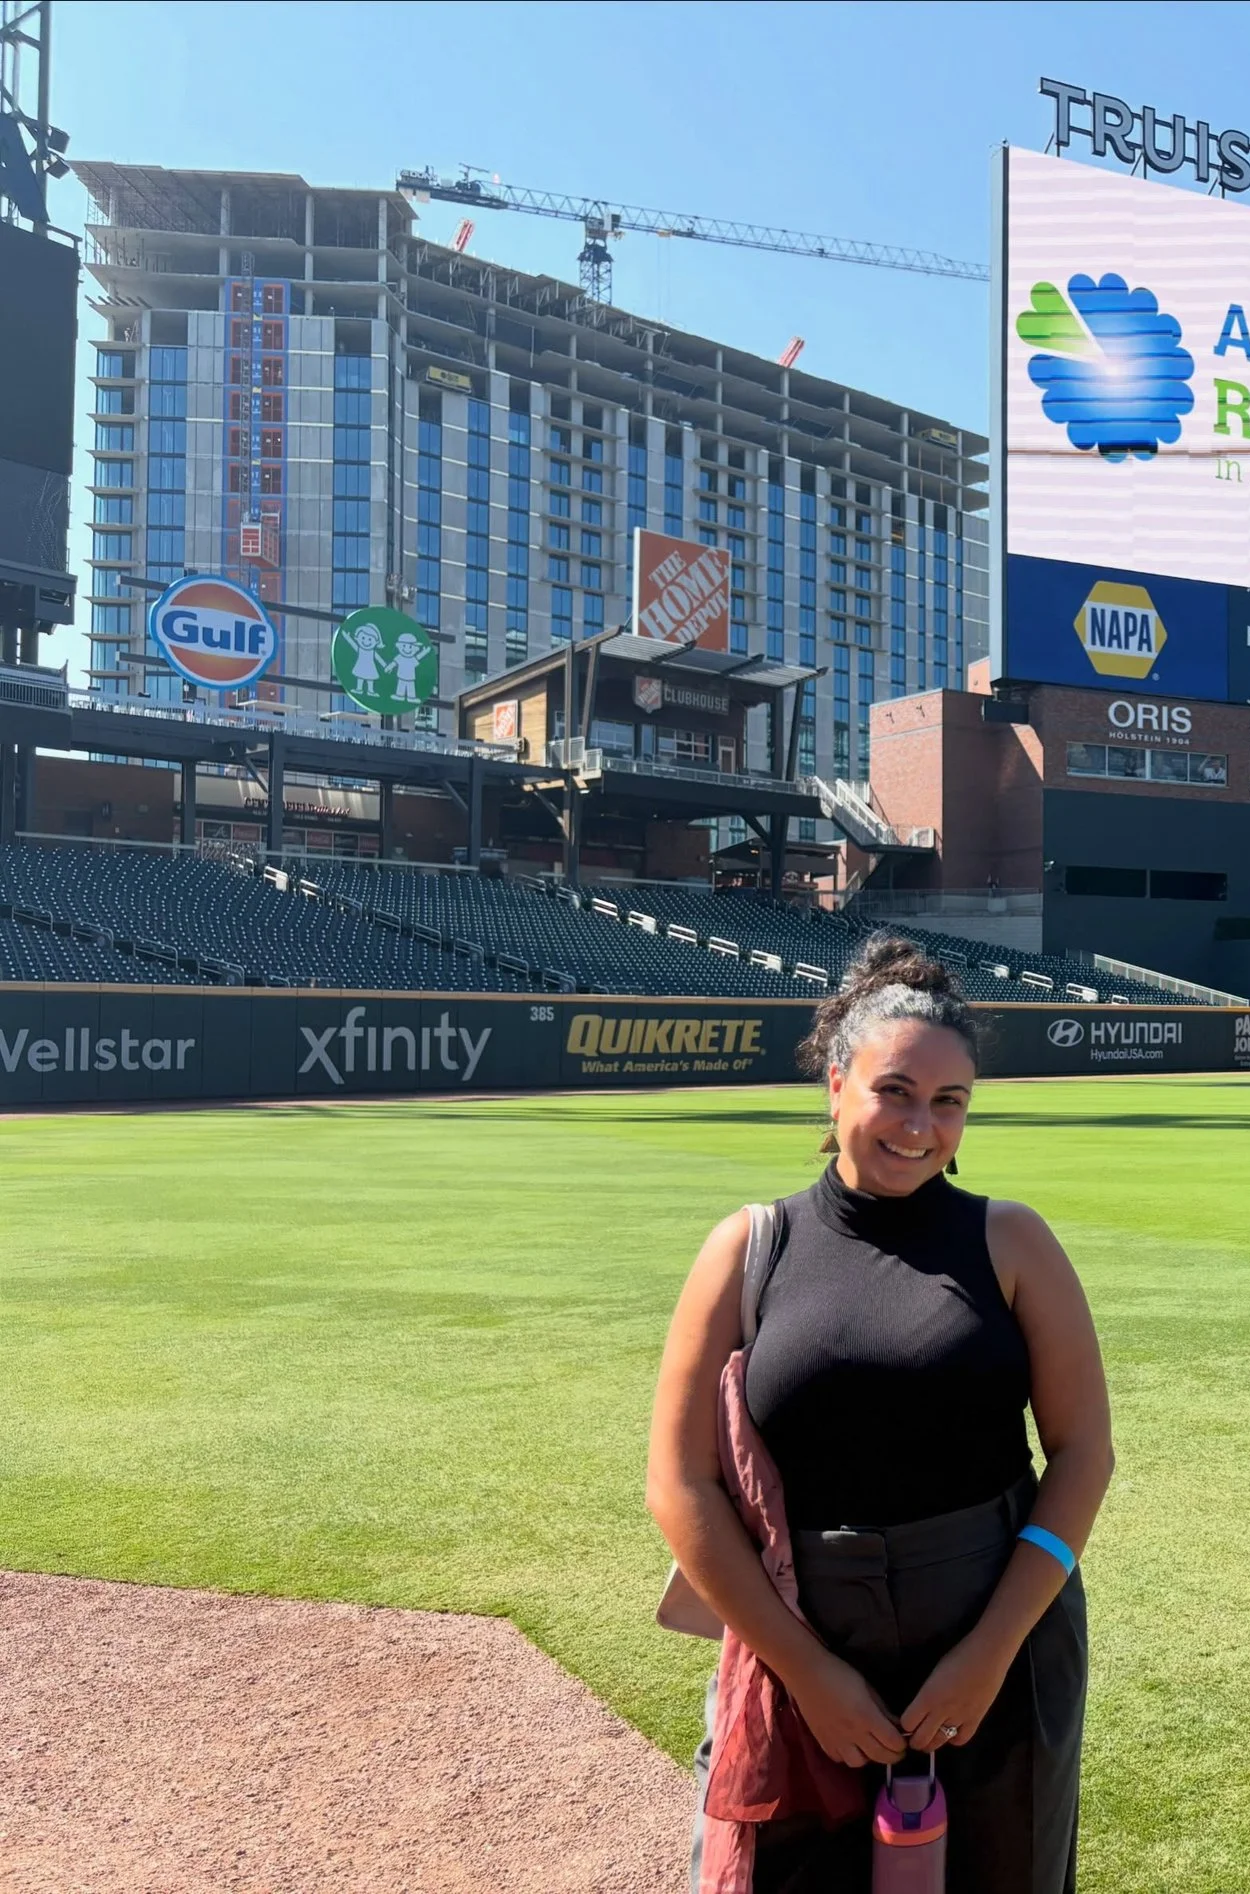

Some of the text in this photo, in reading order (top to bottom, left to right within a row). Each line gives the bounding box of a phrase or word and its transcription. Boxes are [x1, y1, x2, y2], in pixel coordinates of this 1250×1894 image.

[1215, 457, 1243, 483] in
[648, 550, 686, 590] THE
[640, 549, 730, 640] HOME
[162, 610, 266, 655] Gulf
[675, 589, 728, 643] DEPOT
[1090, 607, 1153, 653] NAPA
[664, 687, 729, 712] CLUBHOUSE
[1108, 700, 1192, 734] ORIS
[1166, 737, 1190, 745] 1904
[530, 1006, 554, 1022] 385
[298, 1006, 492, 1085] xfinity
[566, 1014, 763, 1057] QUIKRETE
[1090, 1022, 1183, 1044] HYUNDAI
[581, 1059, 748, 1073] What America's Made Of
